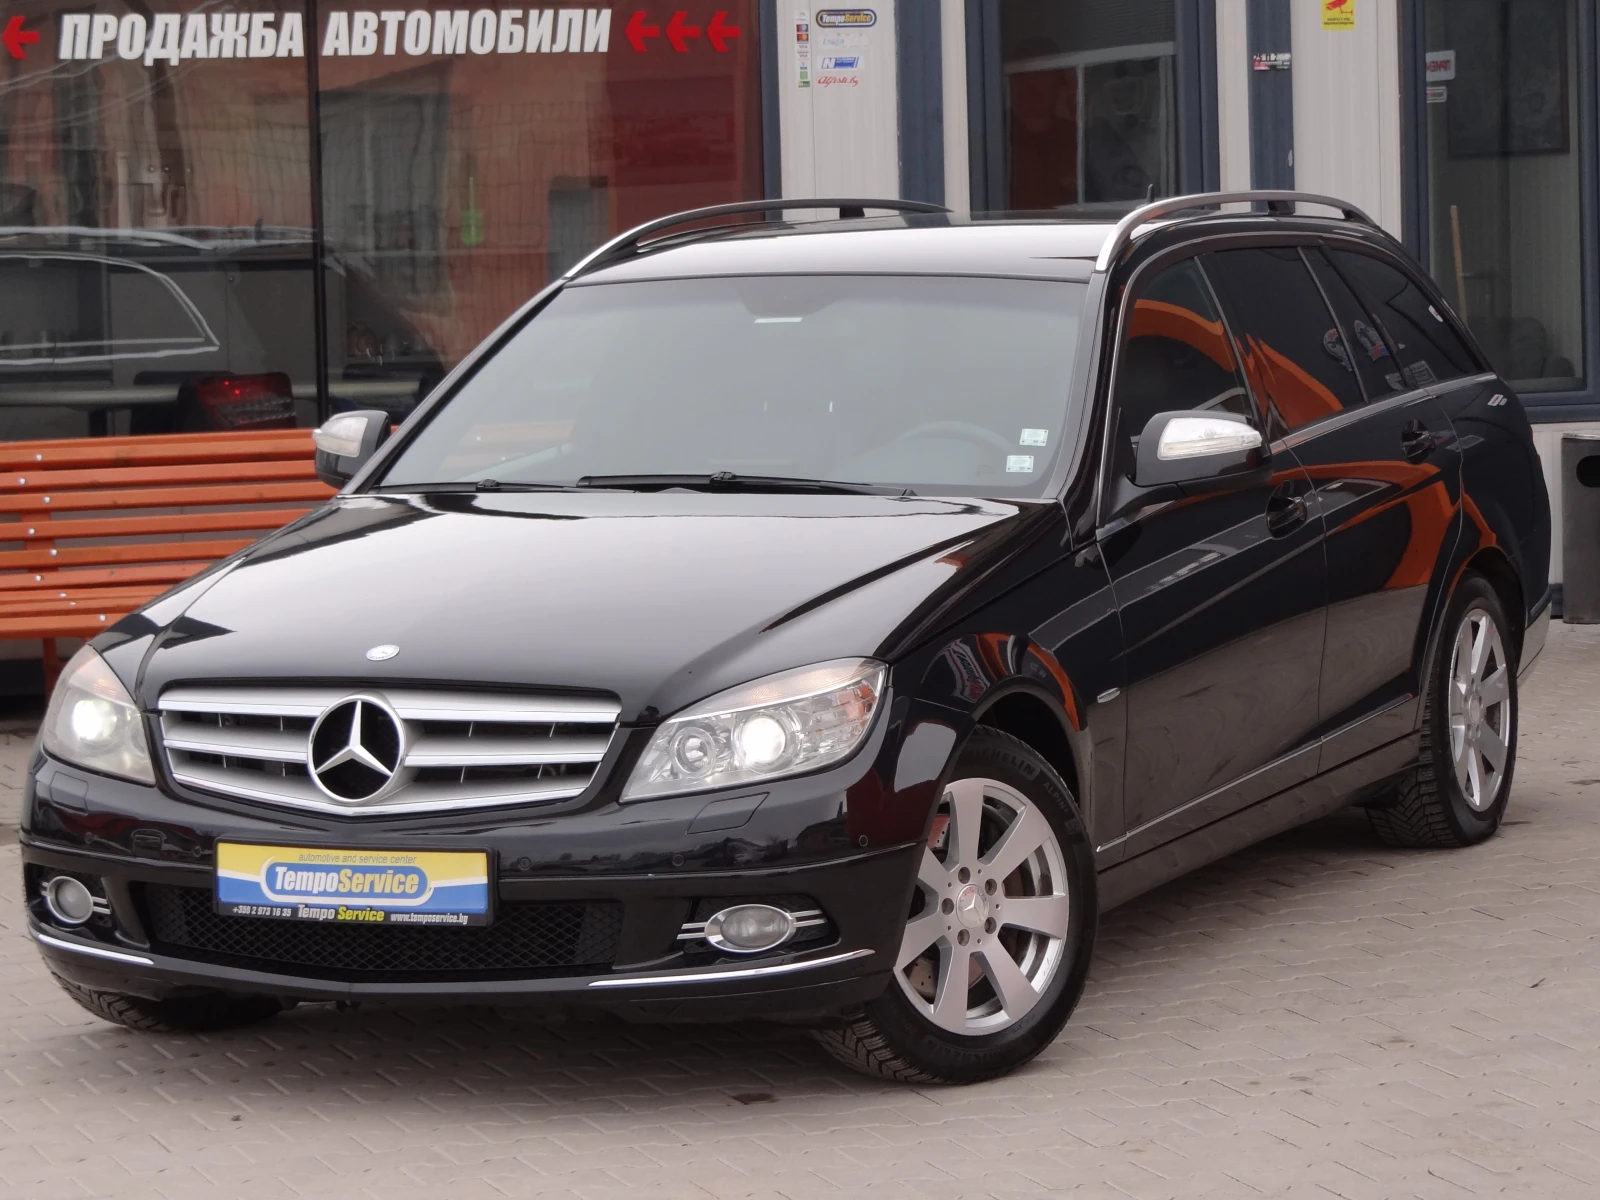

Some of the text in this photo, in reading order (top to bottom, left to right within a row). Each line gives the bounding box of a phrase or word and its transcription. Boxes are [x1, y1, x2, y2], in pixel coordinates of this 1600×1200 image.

[822, 14, 871, 26] TempoService
[58, 8, 612, 67] ПРОДАЖБА АВТОМОБИЛИ
[298, 853, 417, 864] automotive and service center
[275, 866, 420, 894] TempoService
[251, 906, 257, 915] 2
[257, 906, 272, 916] 973
[281, 908, 292, 917] 35
[297, 904, 336, 921] Tempo
[337, 905, 385, 922] Service
[390, 912, 469, 925] www.temposervice.bg
